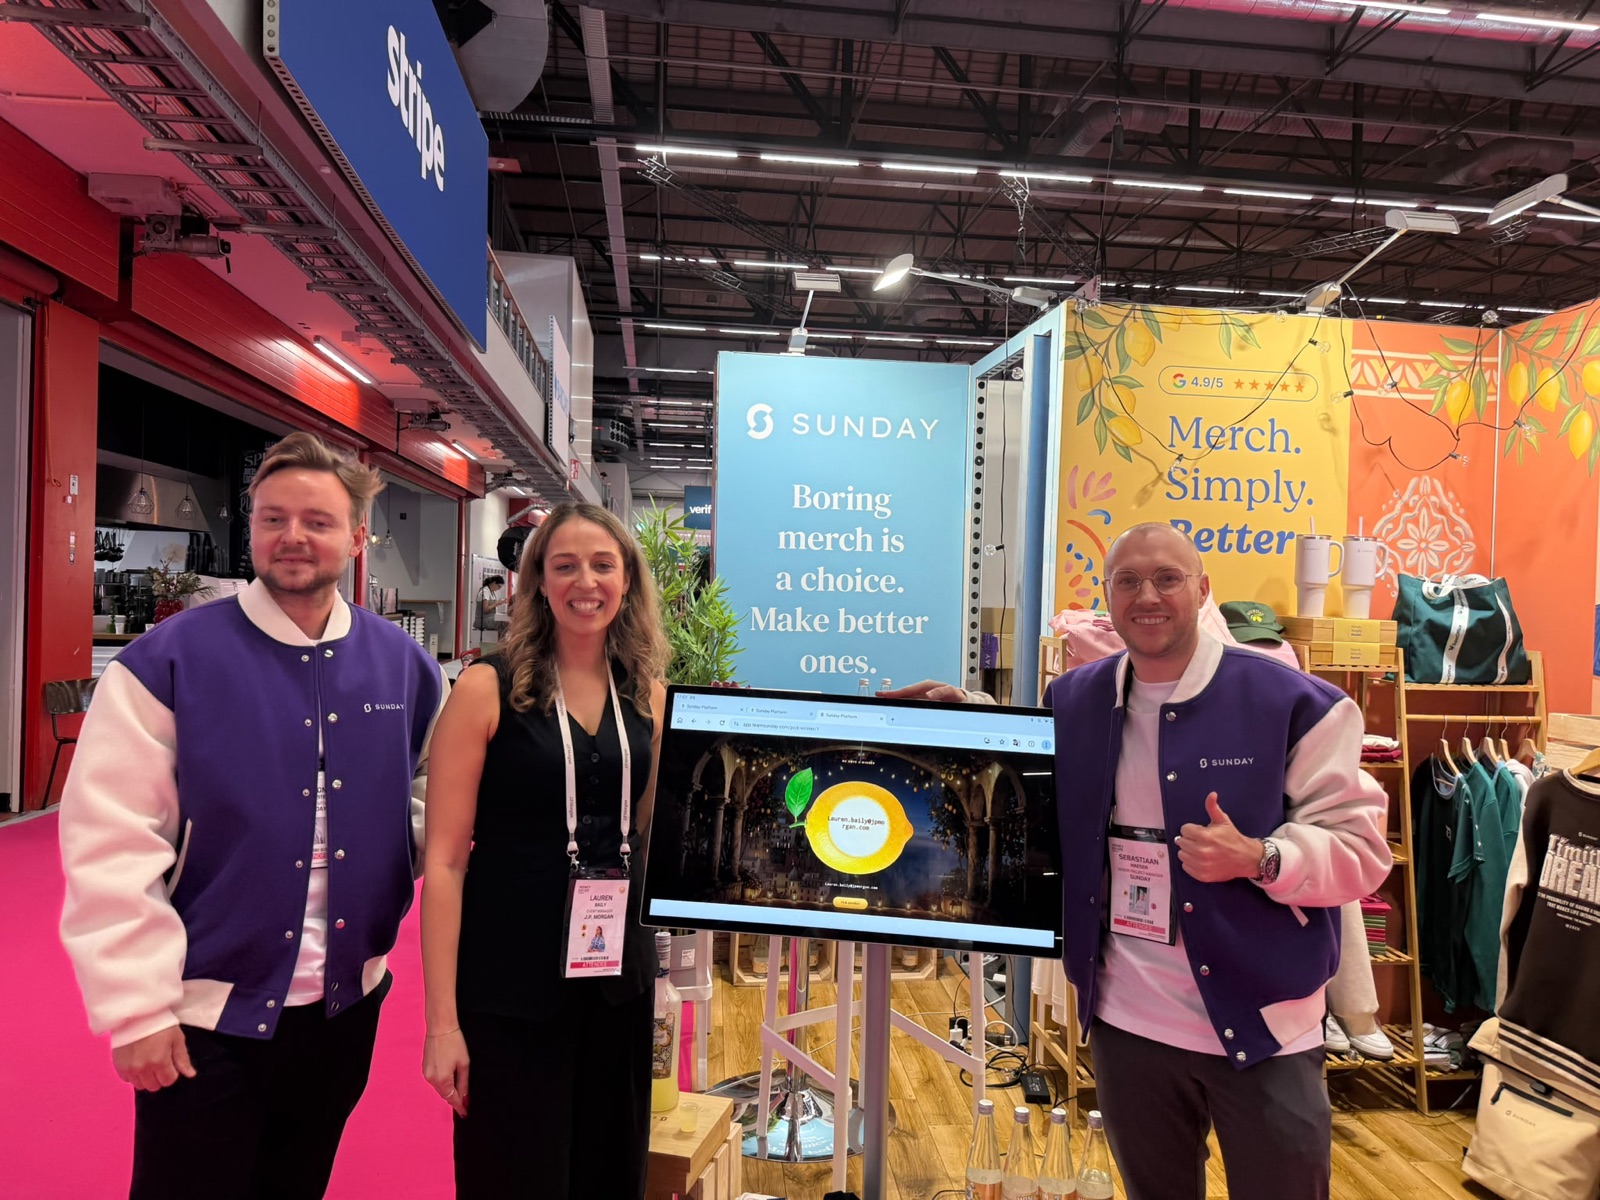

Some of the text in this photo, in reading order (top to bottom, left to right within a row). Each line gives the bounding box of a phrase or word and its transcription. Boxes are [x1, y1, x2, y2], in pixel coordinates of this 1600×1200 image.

[387, 25, 444, 192] stripe
[1191, 376, 1224, 389] 4.9/5
[792, 412, 939, 440] SUNDAY
[1168, 415, 1302, 454] Merch.
[792, 484, 892, 519] Boring
[1165, 466, 1313, 512] Simply.
[777, 527, 905, 553] merch is
[775, 566, 905, 593] a choice.
[750, 606, 930, 634] Make better
[800, 653, 877, 674] ones.
[1211, 757, 1254, 767] SUNDAY
[827, 815, 885, 826] Lauren.baily@jpmo
[1118, 853, 1159, 865] SEBASTIAAN
[1129, 874, 1151, 882] SUNDAY
[1512, 1113, 1536, 1127] SUNDAY
